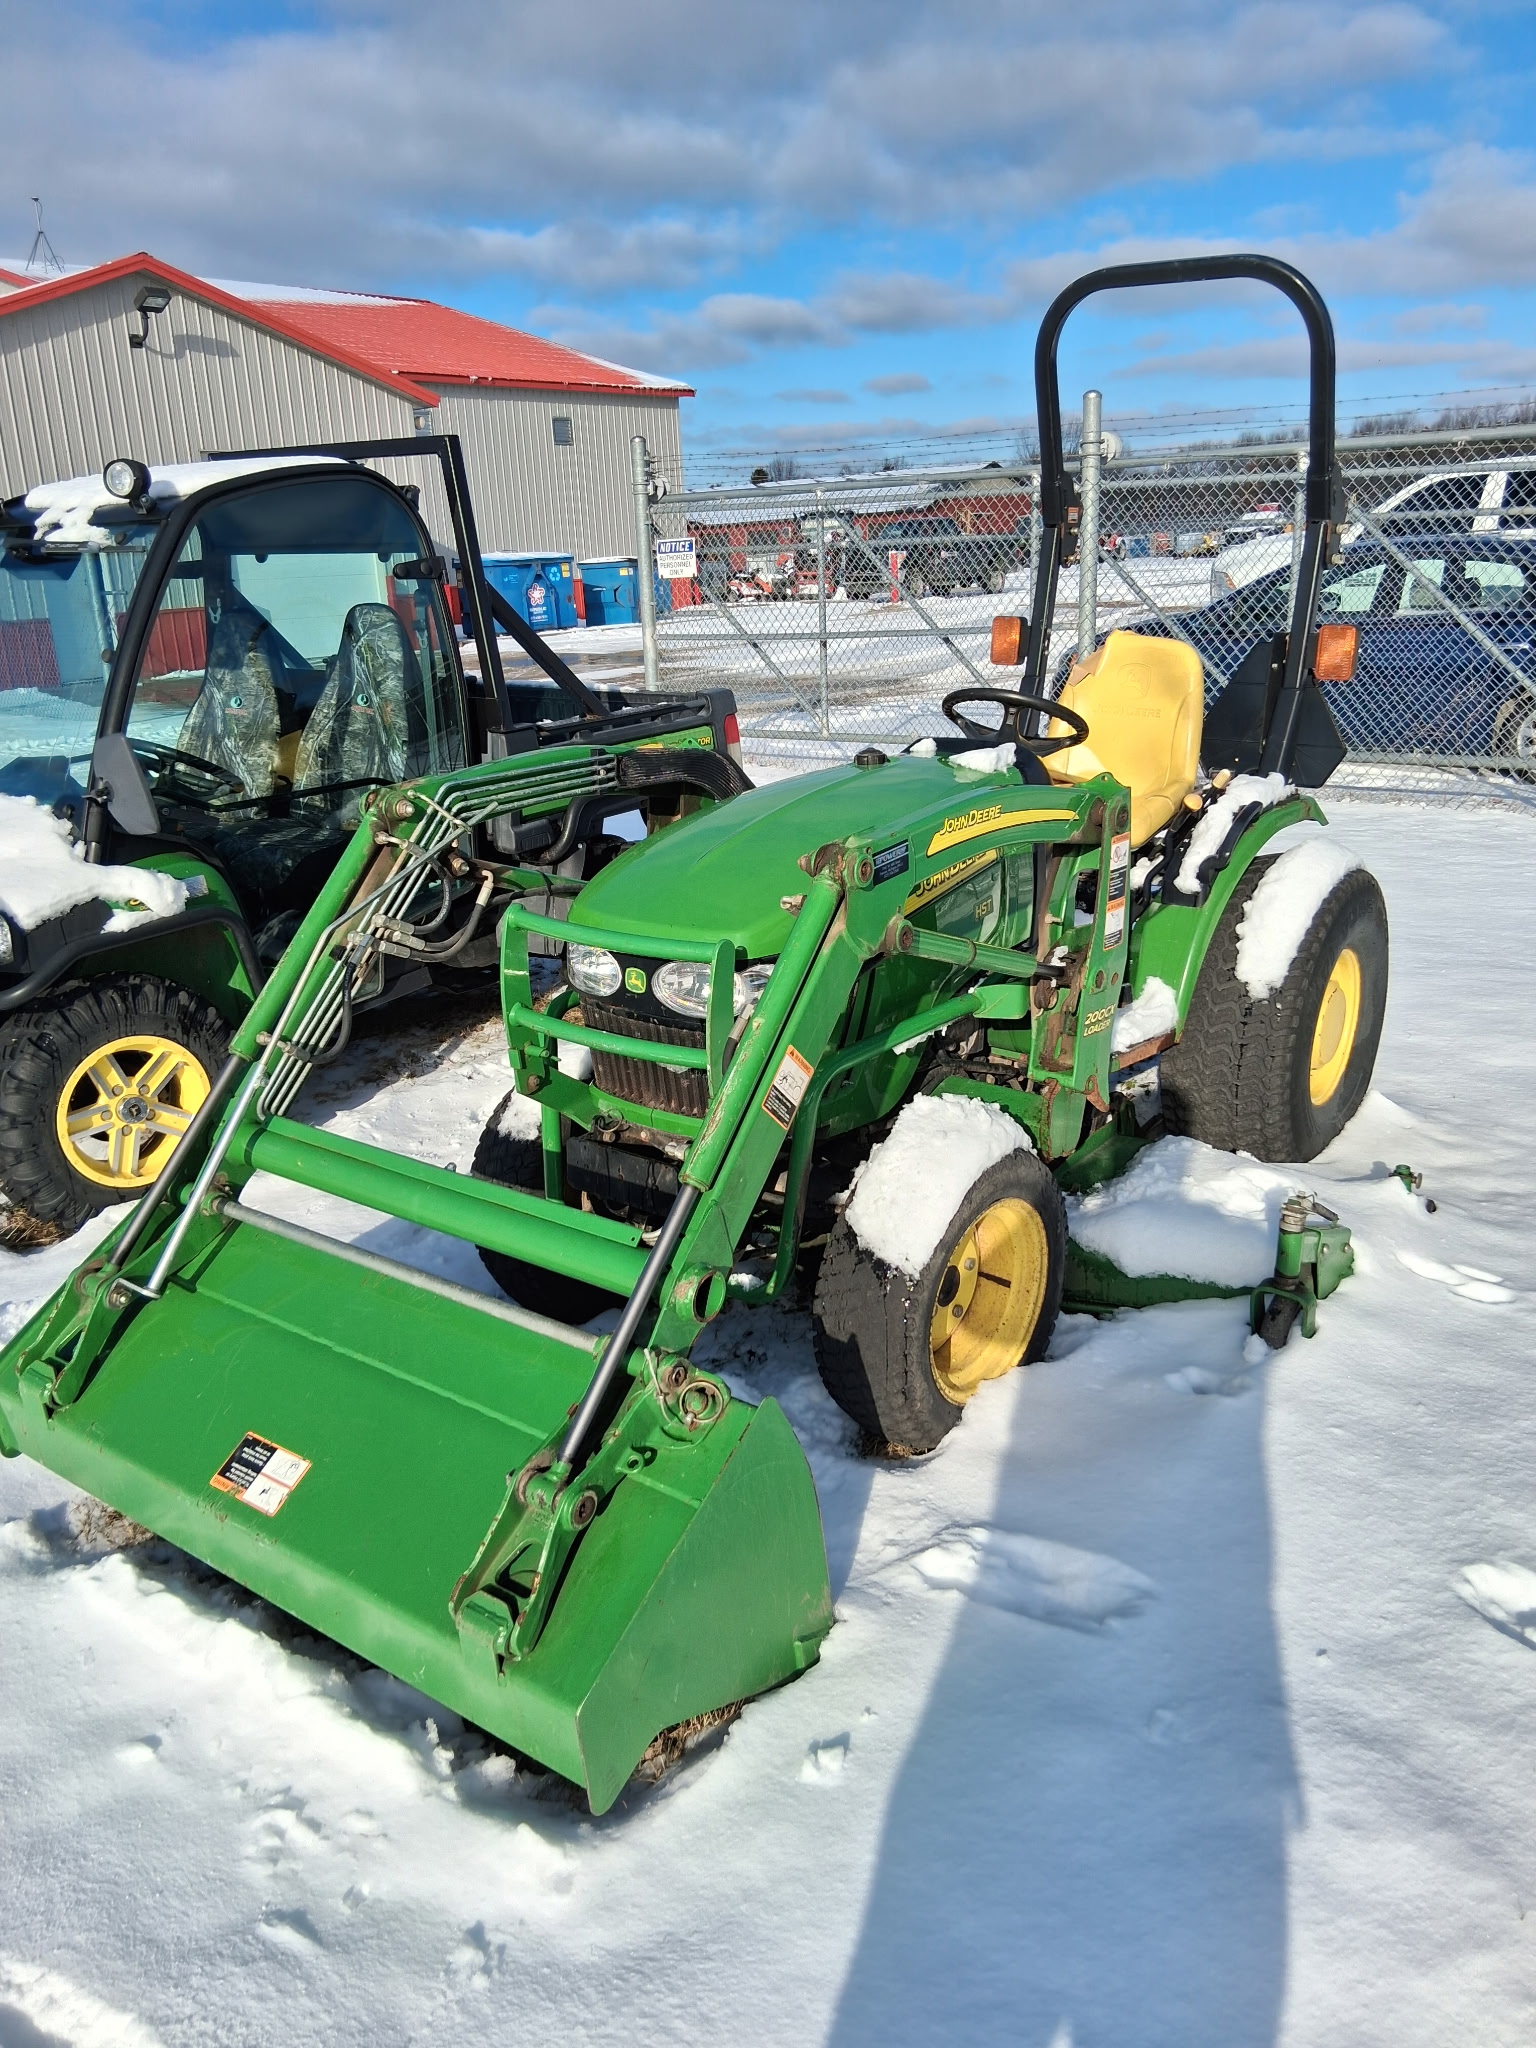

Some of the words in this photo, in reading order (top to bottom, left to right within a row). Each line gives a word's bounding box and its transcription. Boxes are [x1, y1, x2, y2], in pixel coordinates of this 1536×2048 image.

[659, 541, 690, 552] NOTICE
[659, 553, 693, 561] AUTHORIZED
[659, 561, 692, 569] PERSONNEL
[939, 816, 968, 835] JOHN
[968, 804, 1002, 826] DEERE
[976, 900, 992, 918] HST
[1083, 1018, 1111, 1037] LOADER
